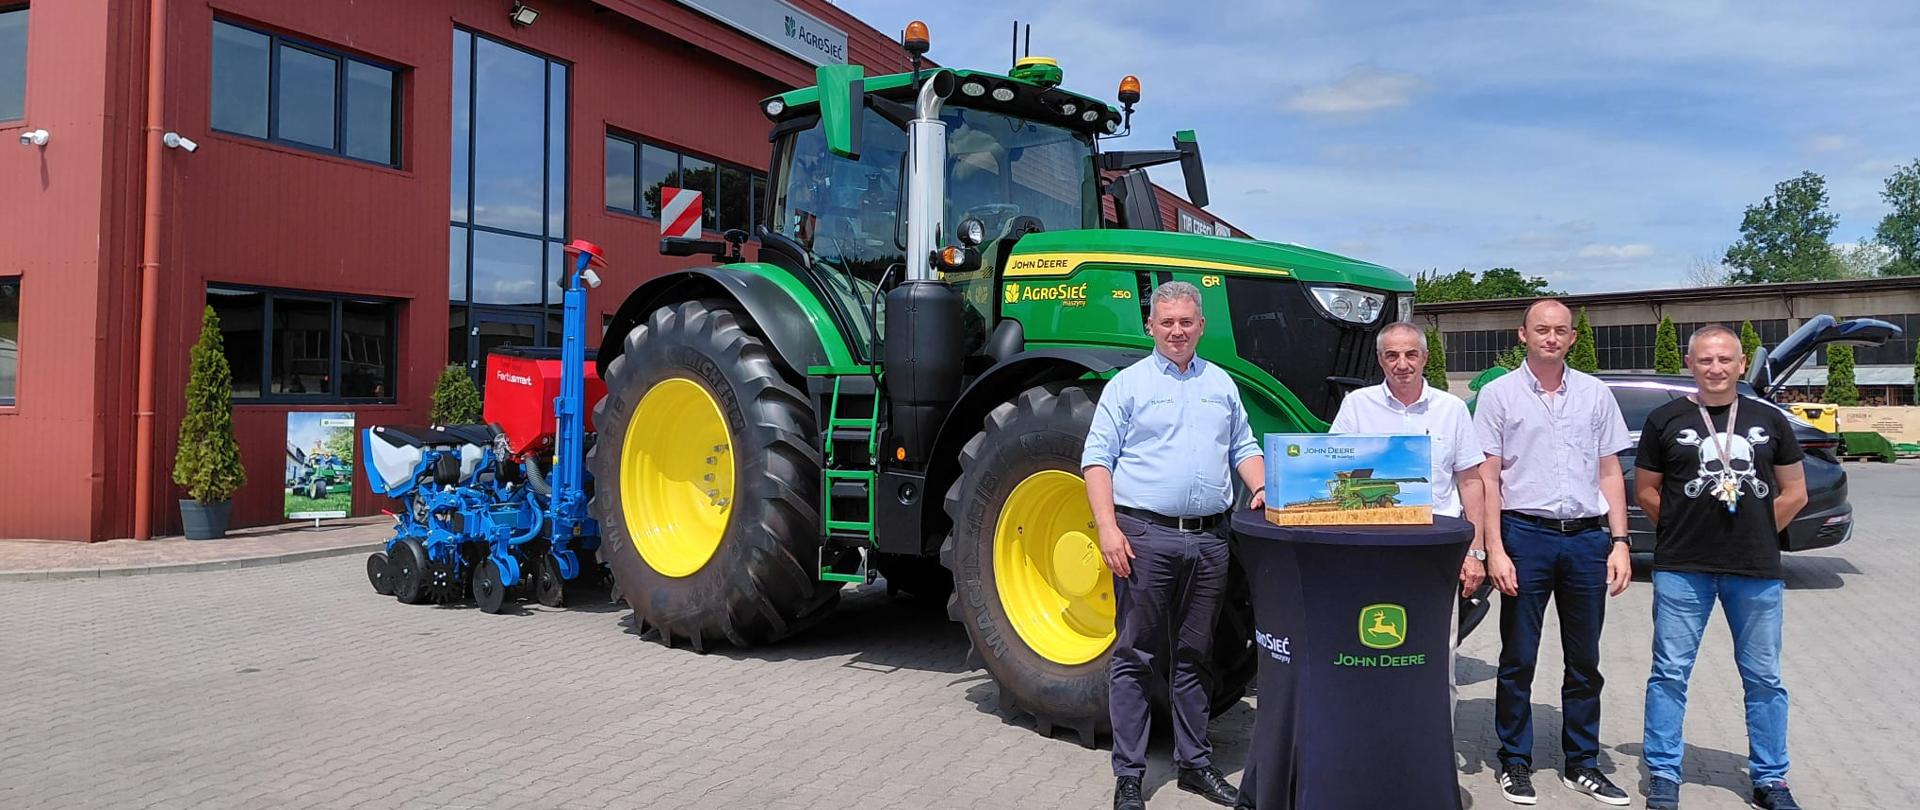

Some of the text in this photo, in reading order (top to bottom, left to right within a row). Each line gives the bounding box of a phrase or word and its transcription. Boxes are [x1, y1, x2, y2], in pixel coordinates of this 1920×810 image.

[1011, 258, 1069, 270] JOHN DEERE
[1201, 275, 1221, 288] 6R
[1111, 289, 1132, 299] 250
[1303, 446, 1356, 455] JOHN DEERE
[1333, 652, 1426, 667] JOHN DEERE
